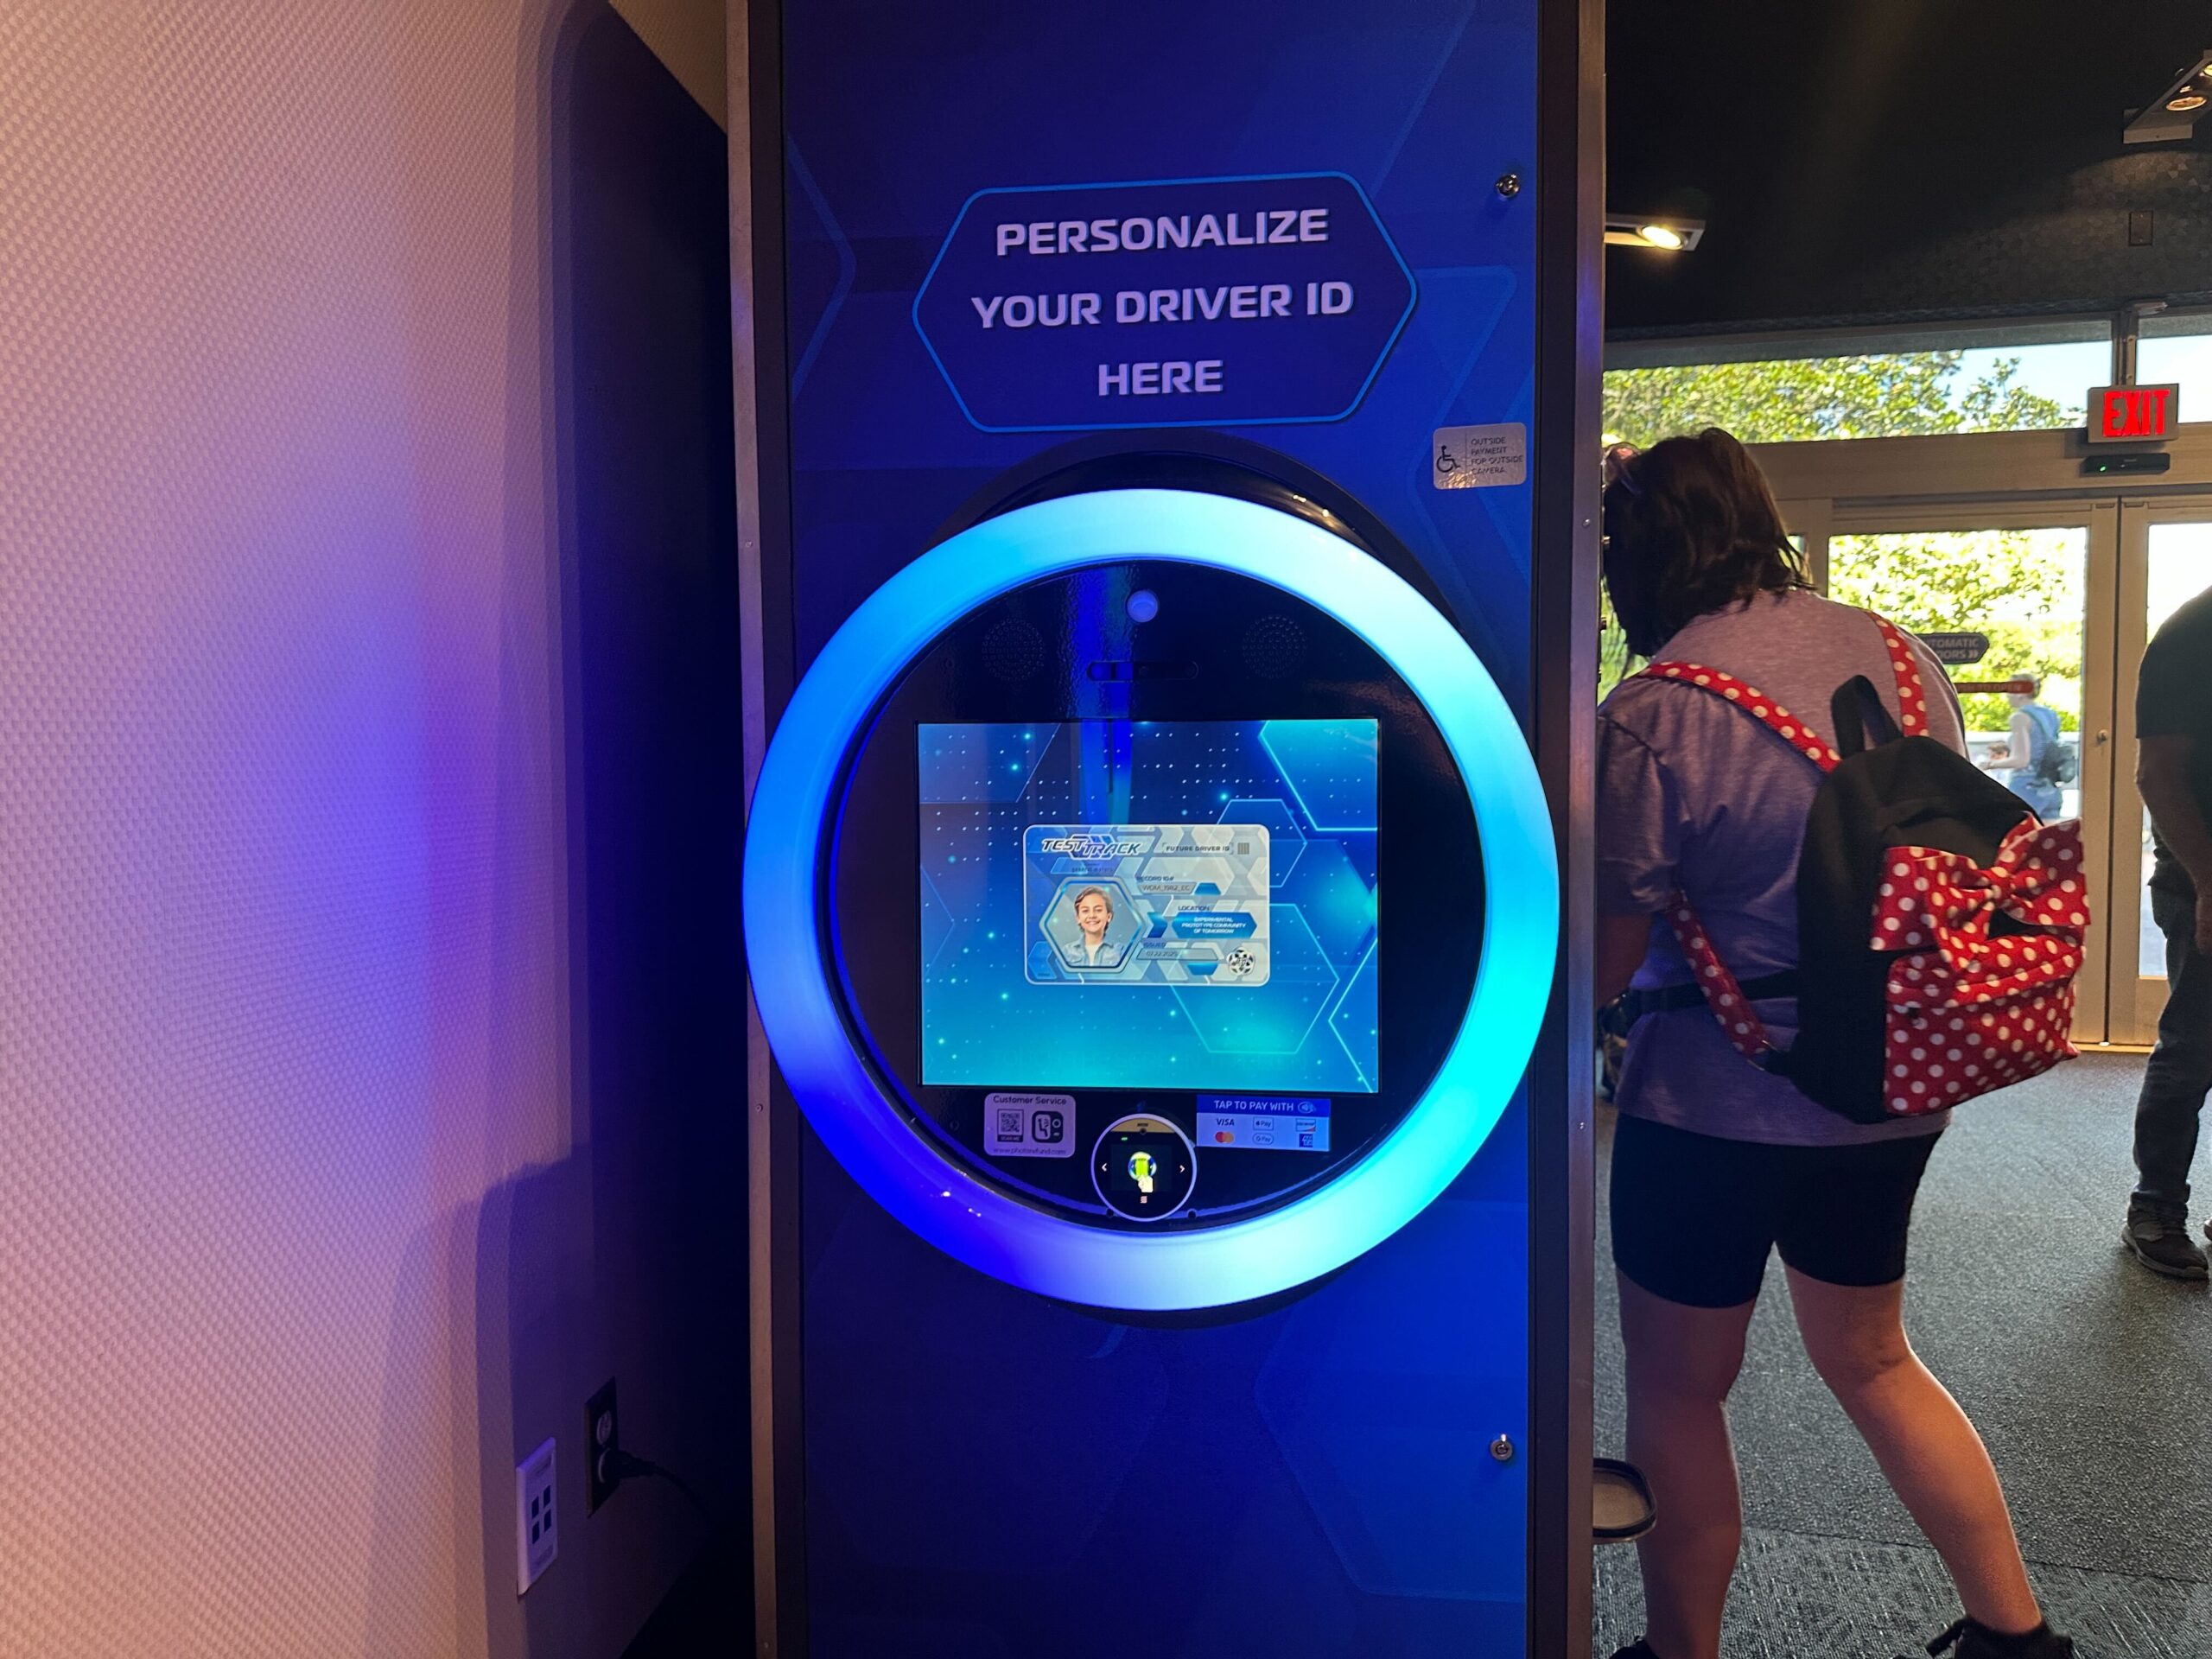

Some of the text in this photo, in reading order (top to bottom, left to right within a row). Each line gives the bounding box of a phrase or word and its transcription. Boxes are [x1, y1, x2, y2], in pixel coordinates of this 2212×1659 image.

[996, 207, 1329, 256] PERSONALIZE
[971, 281, 1354, 328] YOUR DRIVER ID
[1097, 359, 1224, 396] HERE
[2103, 389, 2171, 437] EXIT
[1471, 436, 1506, 445] OUTSIDE
[1471, 447, 1508, 455] PAYMENT
[1471, 456, 1487, 466] FOR
[1042, 838, 1141, 855] TEST TRACK
[993, 1095, 1067, 1105] Customer Service
[1214, 1100, 1294, 1111] TAP TO PAY WITH
[1216, 1118, 1236, 1127] VISA
